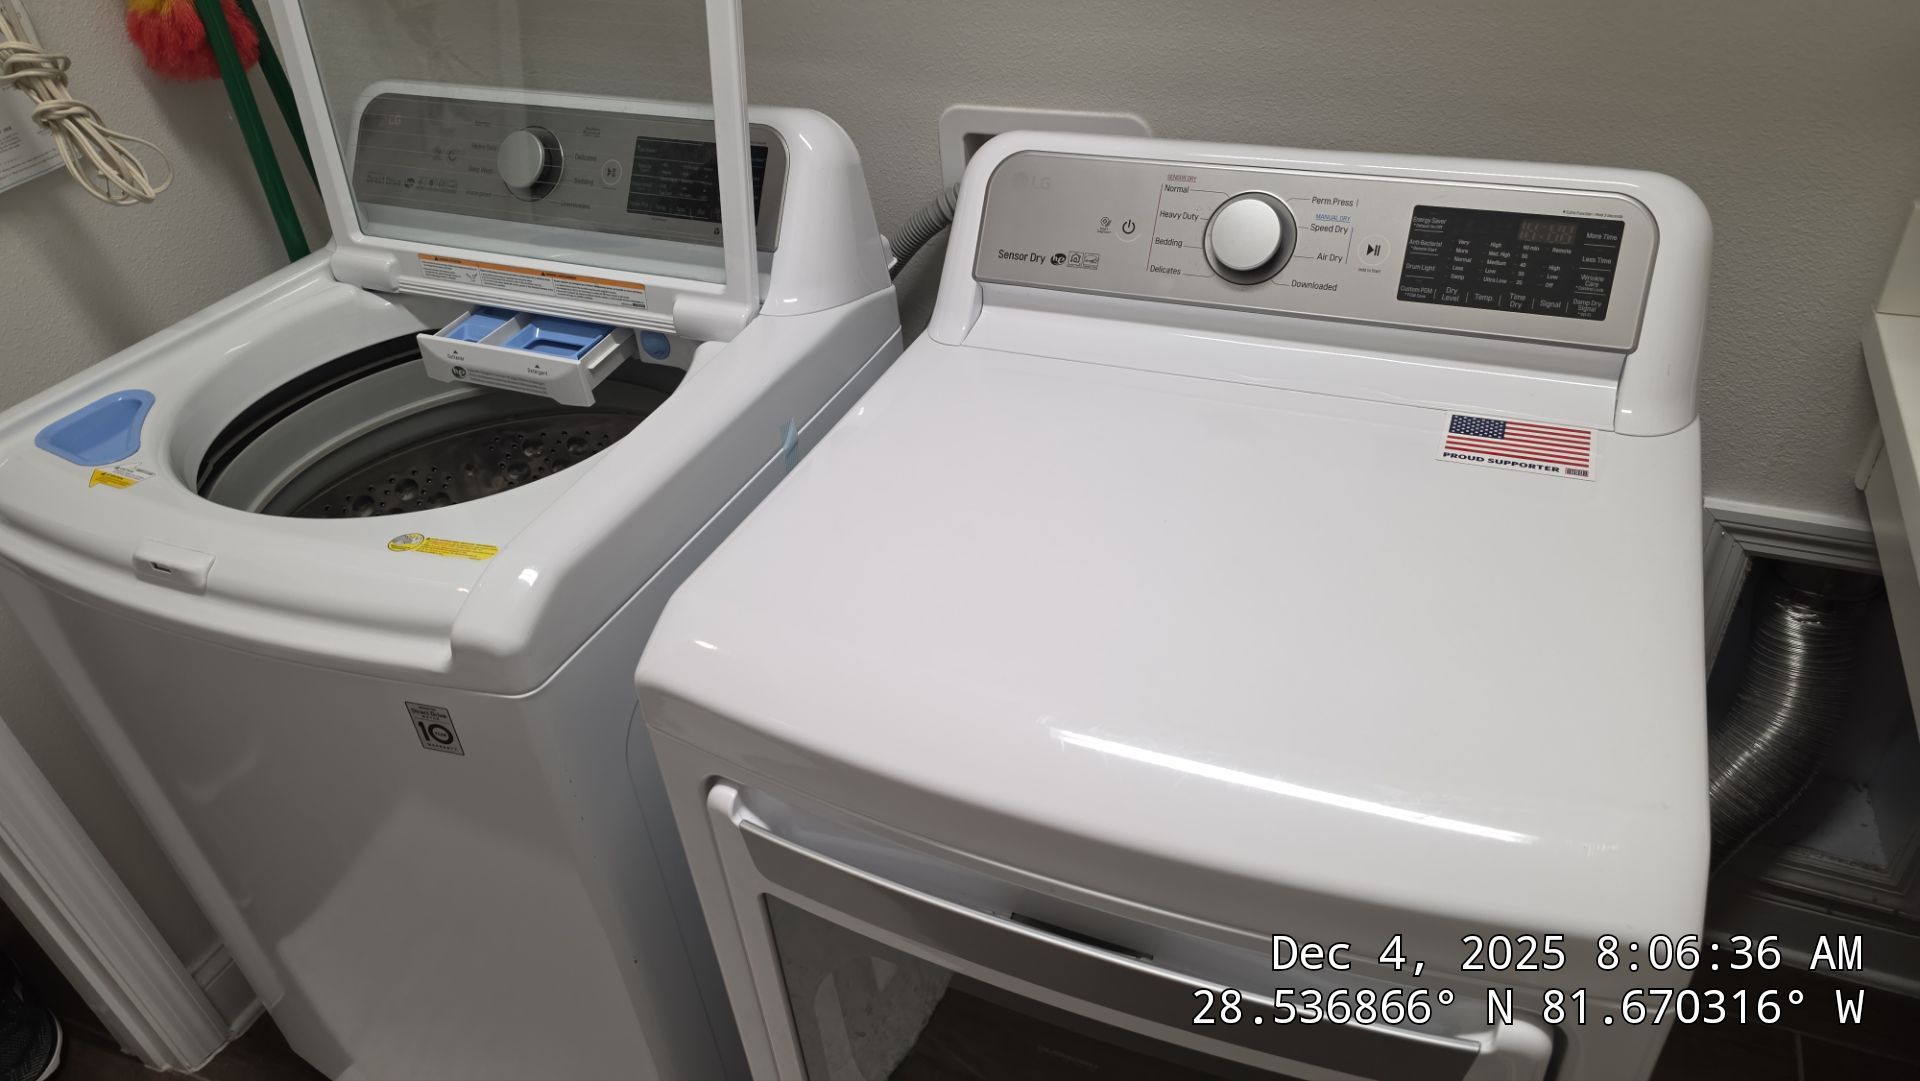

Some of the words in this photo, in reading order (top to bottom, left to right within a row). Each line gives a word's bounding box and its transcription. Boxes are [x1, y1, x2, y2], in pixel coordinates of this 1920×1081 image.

[1031, 176, 1051, 190] LG
[1164, 184, 1189, 193] Normal
[1160, 210, 1181, 221] Heavy
[1182, 212, 1200, 221] Duty
[1315, 213, 1336, 222] MANUAL
[1310, 223, 1331, 234] Speed
[1332, 225, 1349, 235] Dry
[1155, 237, 1182, 247] Bedding
[1603, 233, 1618, 241] Time
[998, 249, 1028, 262] Sensor
[1029, 252, 1046, 265] Dry
[1317, 253, 1329, 261] Air
[1329, 254, 1343, 264] Dry
[1150, 265, 1181, 275] Delicates
[1291, 279, 1337, 292] Downloaded
[1400, 285, 1420, 293] Custom
[1446, 287, 1458, 295] Dry
[1442, 294, 1460, 302] Level
[1510, 293, 1526, 301] Time
[1510, 301, 1522, 309] Dry
[1540, 299, 1561, 309] Signal
[1590, 299, 1602, 307] Dry
[1443, 451, 1484, 462] PROUD
[1488, 456, 1560, 473] SUPPORTER
[418, 721, 454, 745] 10
